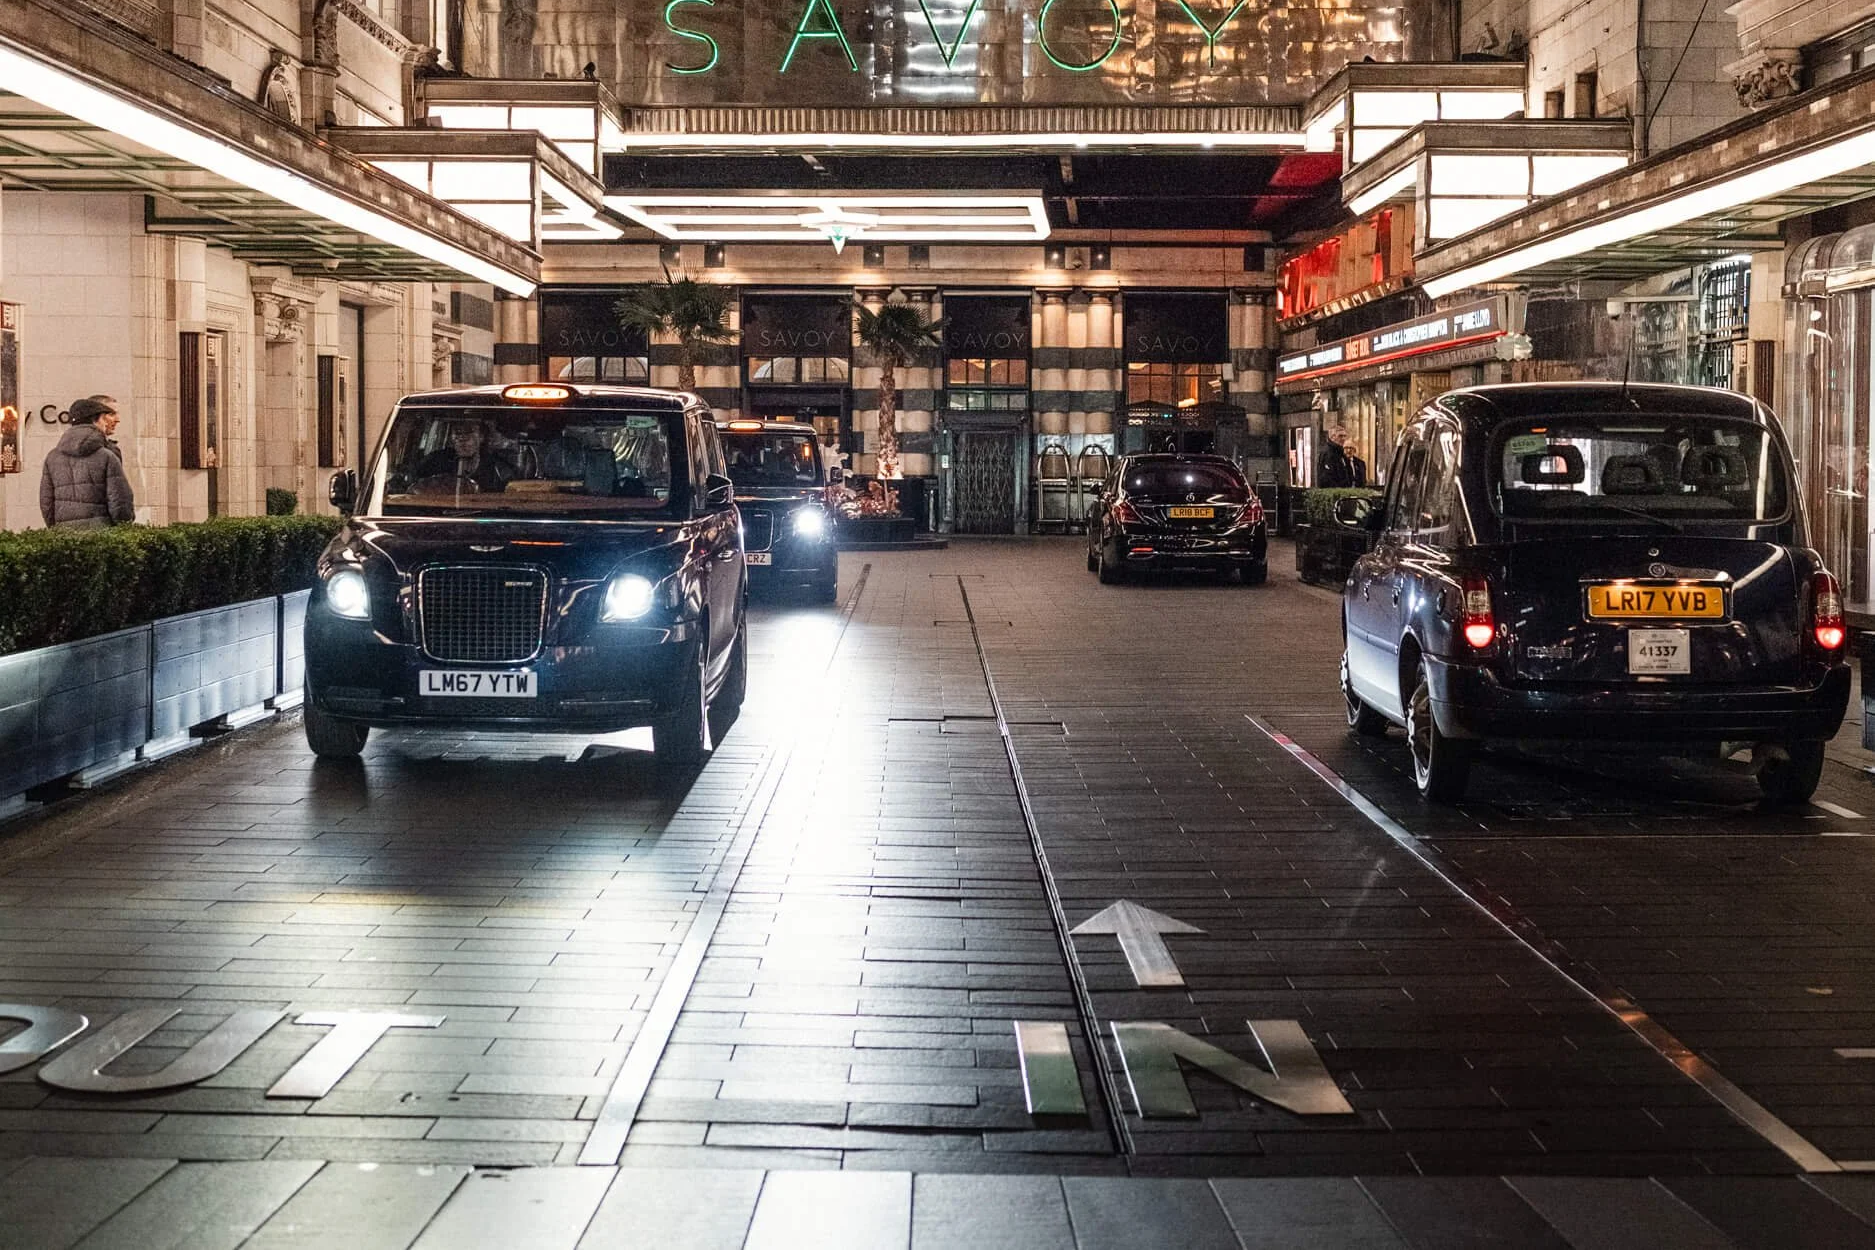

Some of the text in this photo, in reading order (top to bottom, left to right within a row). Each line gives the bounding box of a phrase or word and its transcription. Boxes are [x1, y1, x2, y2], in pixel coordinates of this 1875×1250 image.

[559, 329, 630, 347] SAVOY
[760, 330, 834, 347] SAVOY
[950, 332, 1024, 349] SAVOY
[1138, 335, 1216, 352] SAVOY
[511, 389, 564, 397] TAXI
[747, 554, 766, 564] CRZ
[1606, 591, 1707, 611] LR17 YVB
[1640, 645, 1678, 657] 41337
[428, 673, 529, 693] LM67 YTW
[1013, 1019, 1355, 1118] IN
